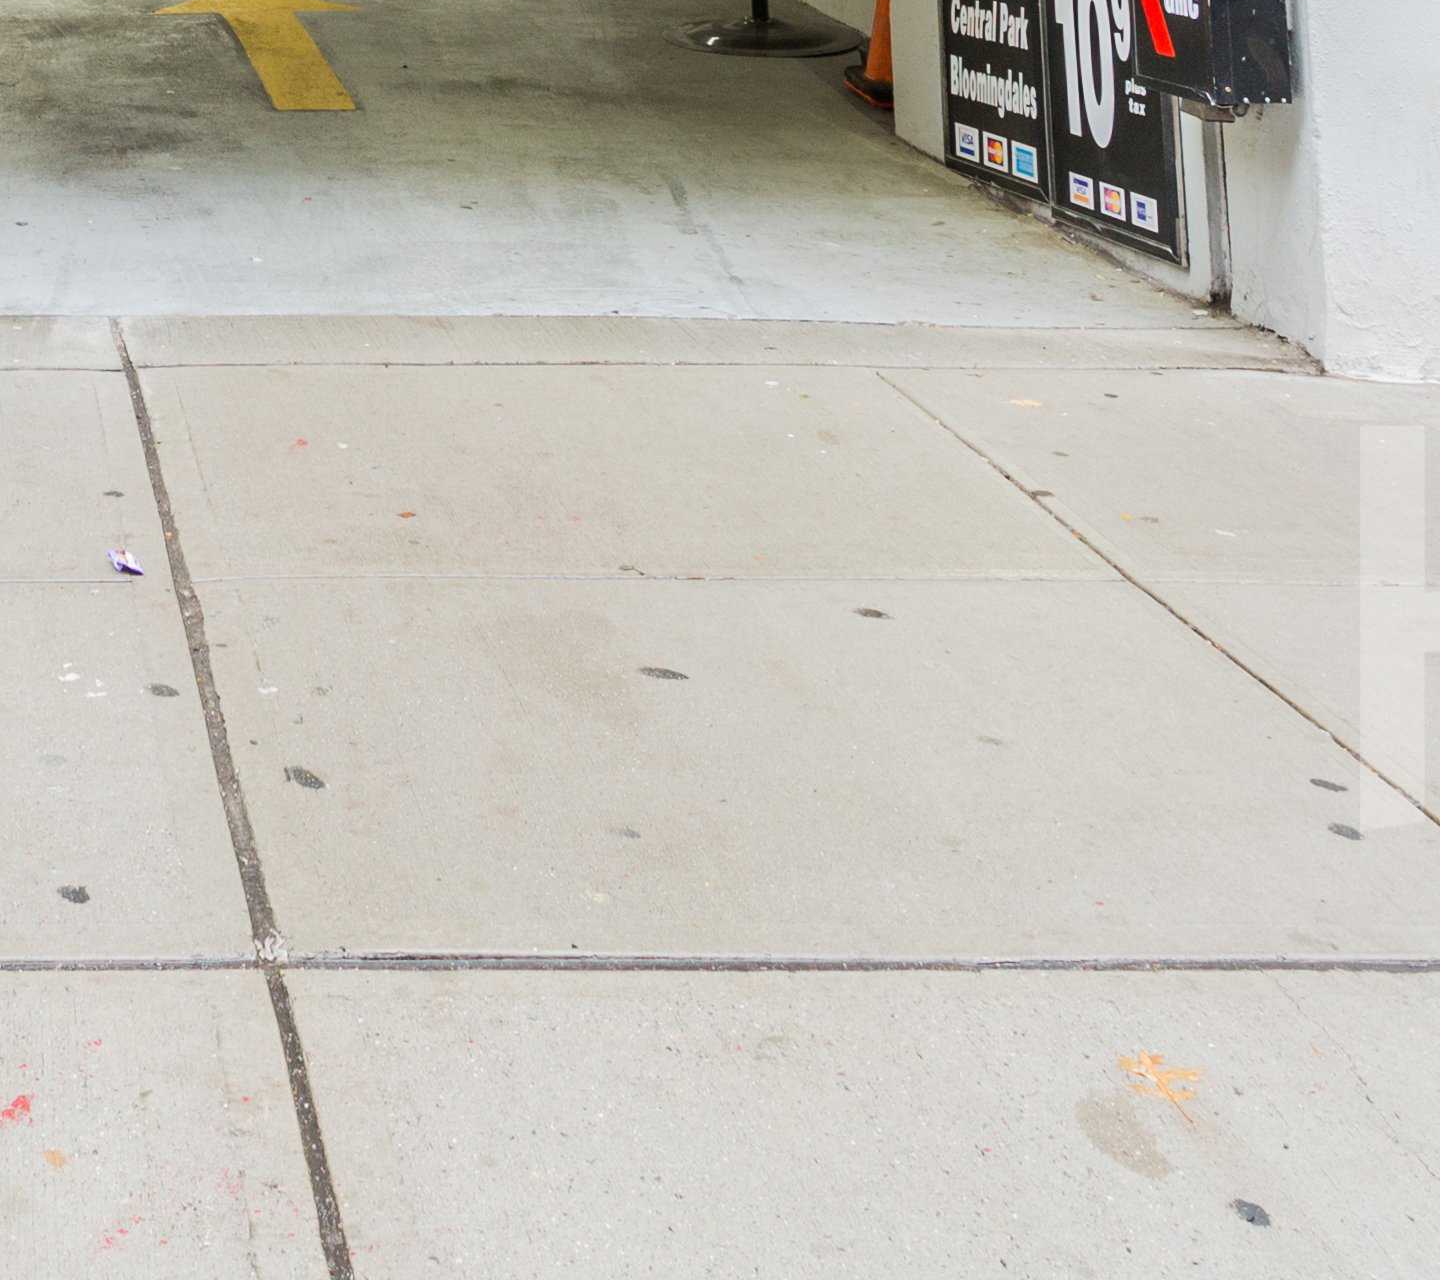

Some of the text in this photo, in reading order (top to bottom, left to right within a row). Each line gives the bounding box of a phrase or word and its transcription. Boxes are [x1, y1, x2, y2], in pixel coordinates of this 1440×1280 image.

[999, 2, 1029, 50] Park
[950, 54, 1037, 119] Bloomingdales
[1128, 97, 1146, 117] tax
